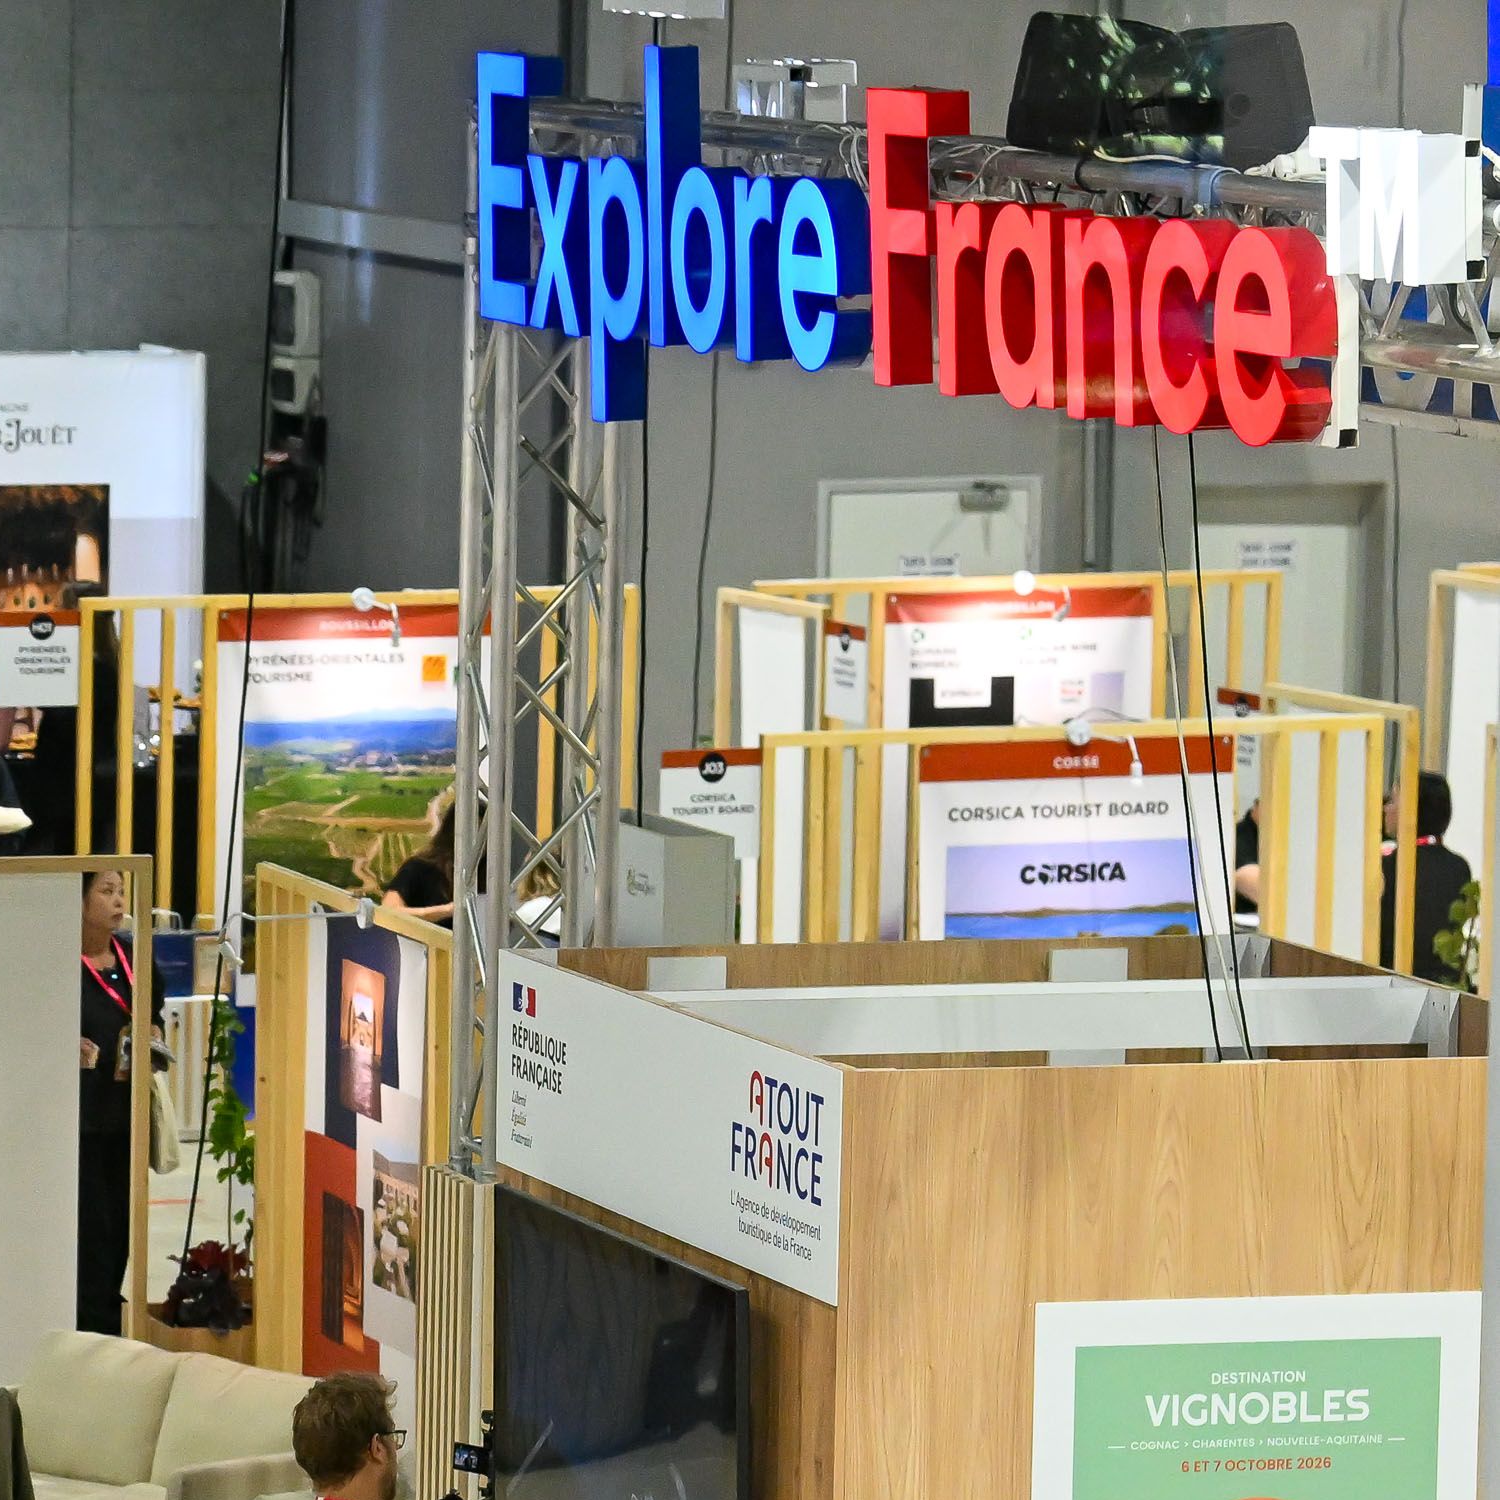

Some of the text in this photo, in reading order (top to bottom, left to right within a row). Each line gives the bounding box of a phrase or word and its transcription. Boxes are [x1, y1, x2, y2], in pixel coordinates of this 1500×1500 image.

[476, 45, 872, 422] Explore
[866, 86, 1325, 447] France
[672, 804, 755, 816] TOURIST BOARD
[690, 793, 736, 803] CORSICA
[949, 800, 1169, 822] CORSICA TOURIST BOARD
[1020, 861, 1127, 885] CORSICA
[512, 1020, 567, 1066] RÉPUBLIQUE
[511, 1054, 562, 1094] FRANÇAISE
[750, 1071, 824, 1146] ATOUT
[731, 1122, 823, 1207] FRANCE
[737, 1192, 760, 1216] Agence
[761, 1203, 770, 1219] de
[770, 1205, 821, 1241] développement
[738, 1216, 772, 1245] touristique
[773, 1230, 782, 1248] de
[790, 1236, 812, 1261] France
[1211, 1371, 1306, 1385] DESTINATION
[1145, 1389, 1370, 1427] VIGNOBLES
[1131, 1434, 1383, 1451] COGNAC CHARENTES NOUVELLE-AQUITAINE
[1181, 1456, 1332, 1472] 6 ET 7 OCTOBRE 2026
